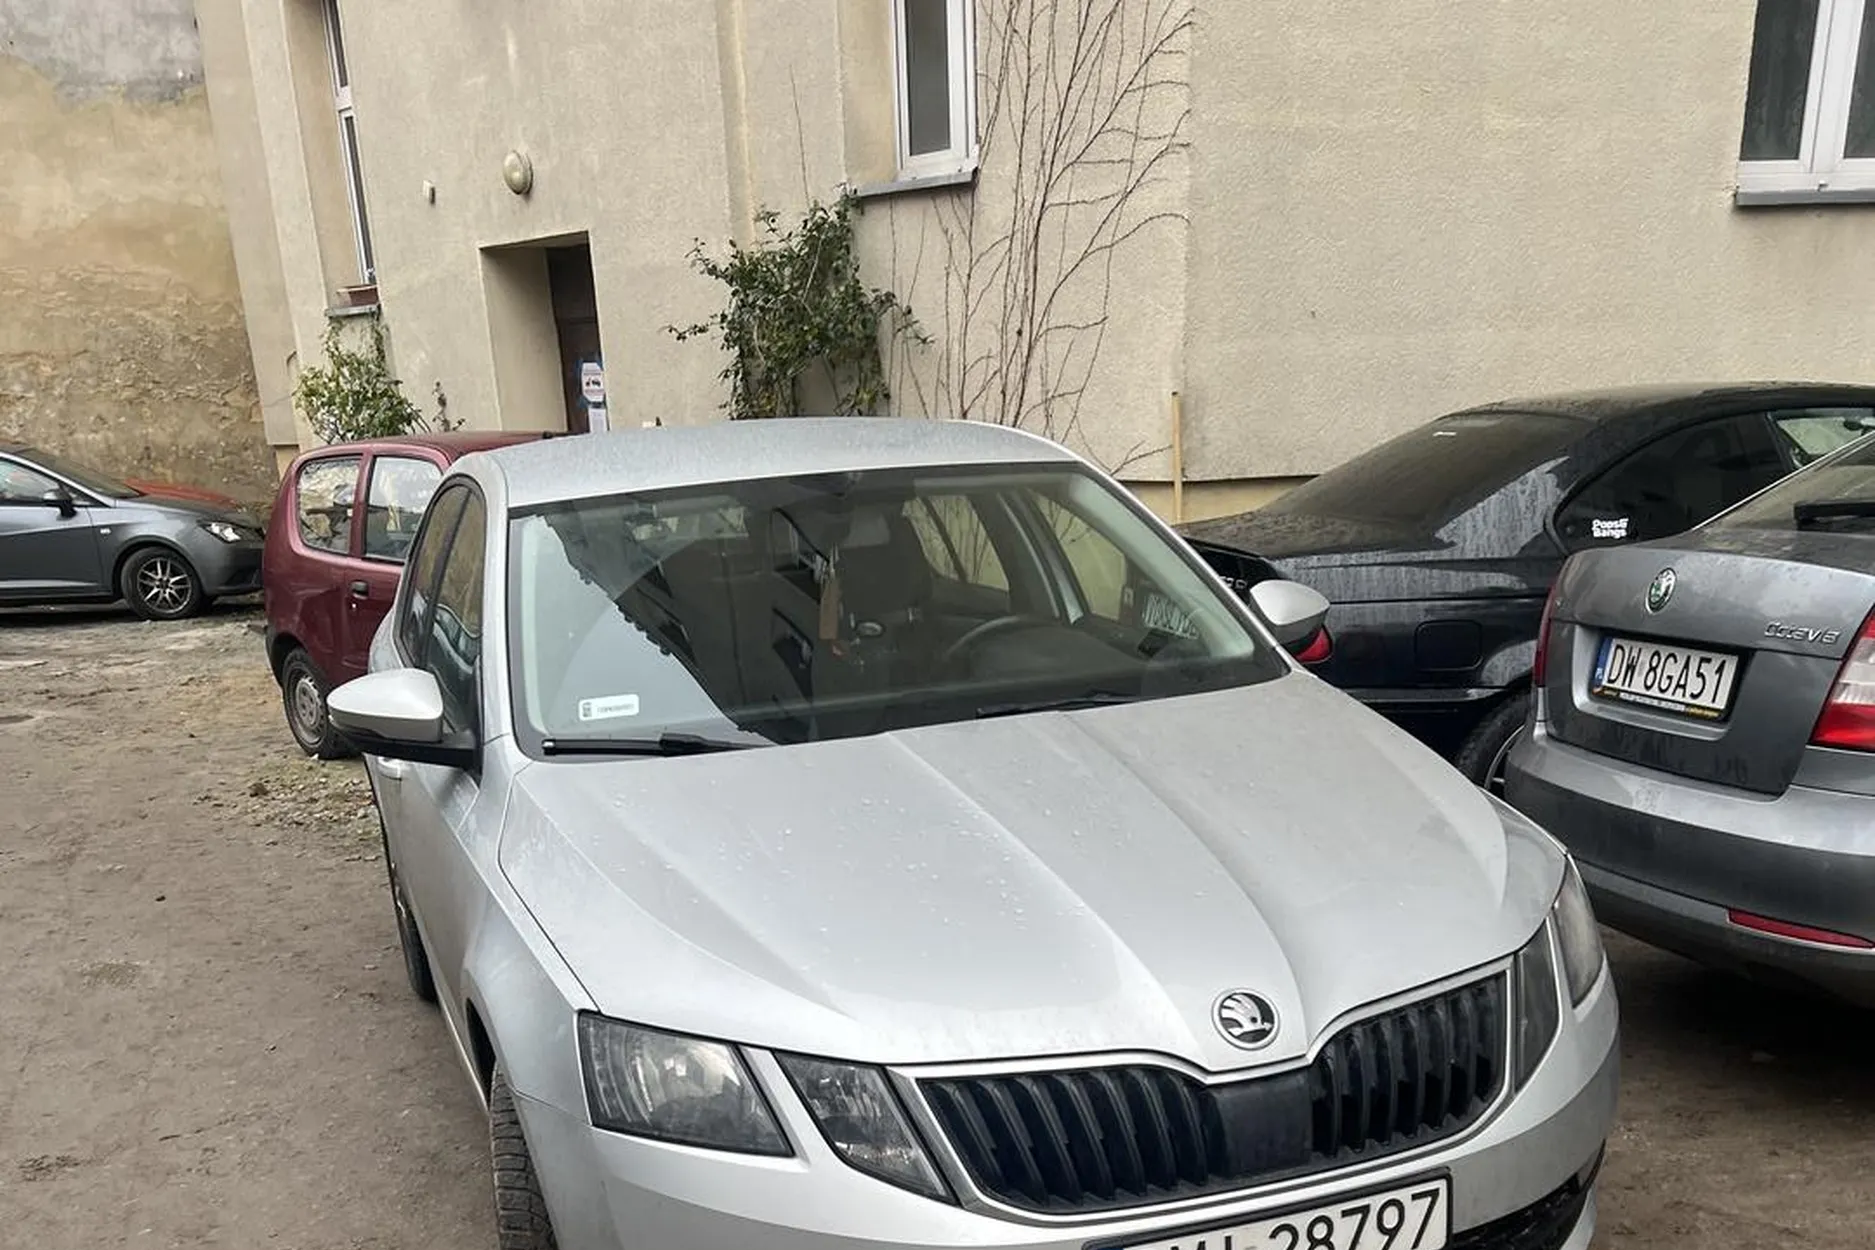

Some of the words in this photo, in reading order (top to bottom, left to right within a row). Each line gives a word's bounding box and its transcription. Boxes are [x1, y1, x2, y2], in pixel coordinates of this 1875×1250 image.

[1592, 528, 1627, 539] Bangs
[1764, 620, 1840, 644] Octavia
[1608, 644, 1640, 685] DW
[1643, 650, 1727, 703] 8GA51
